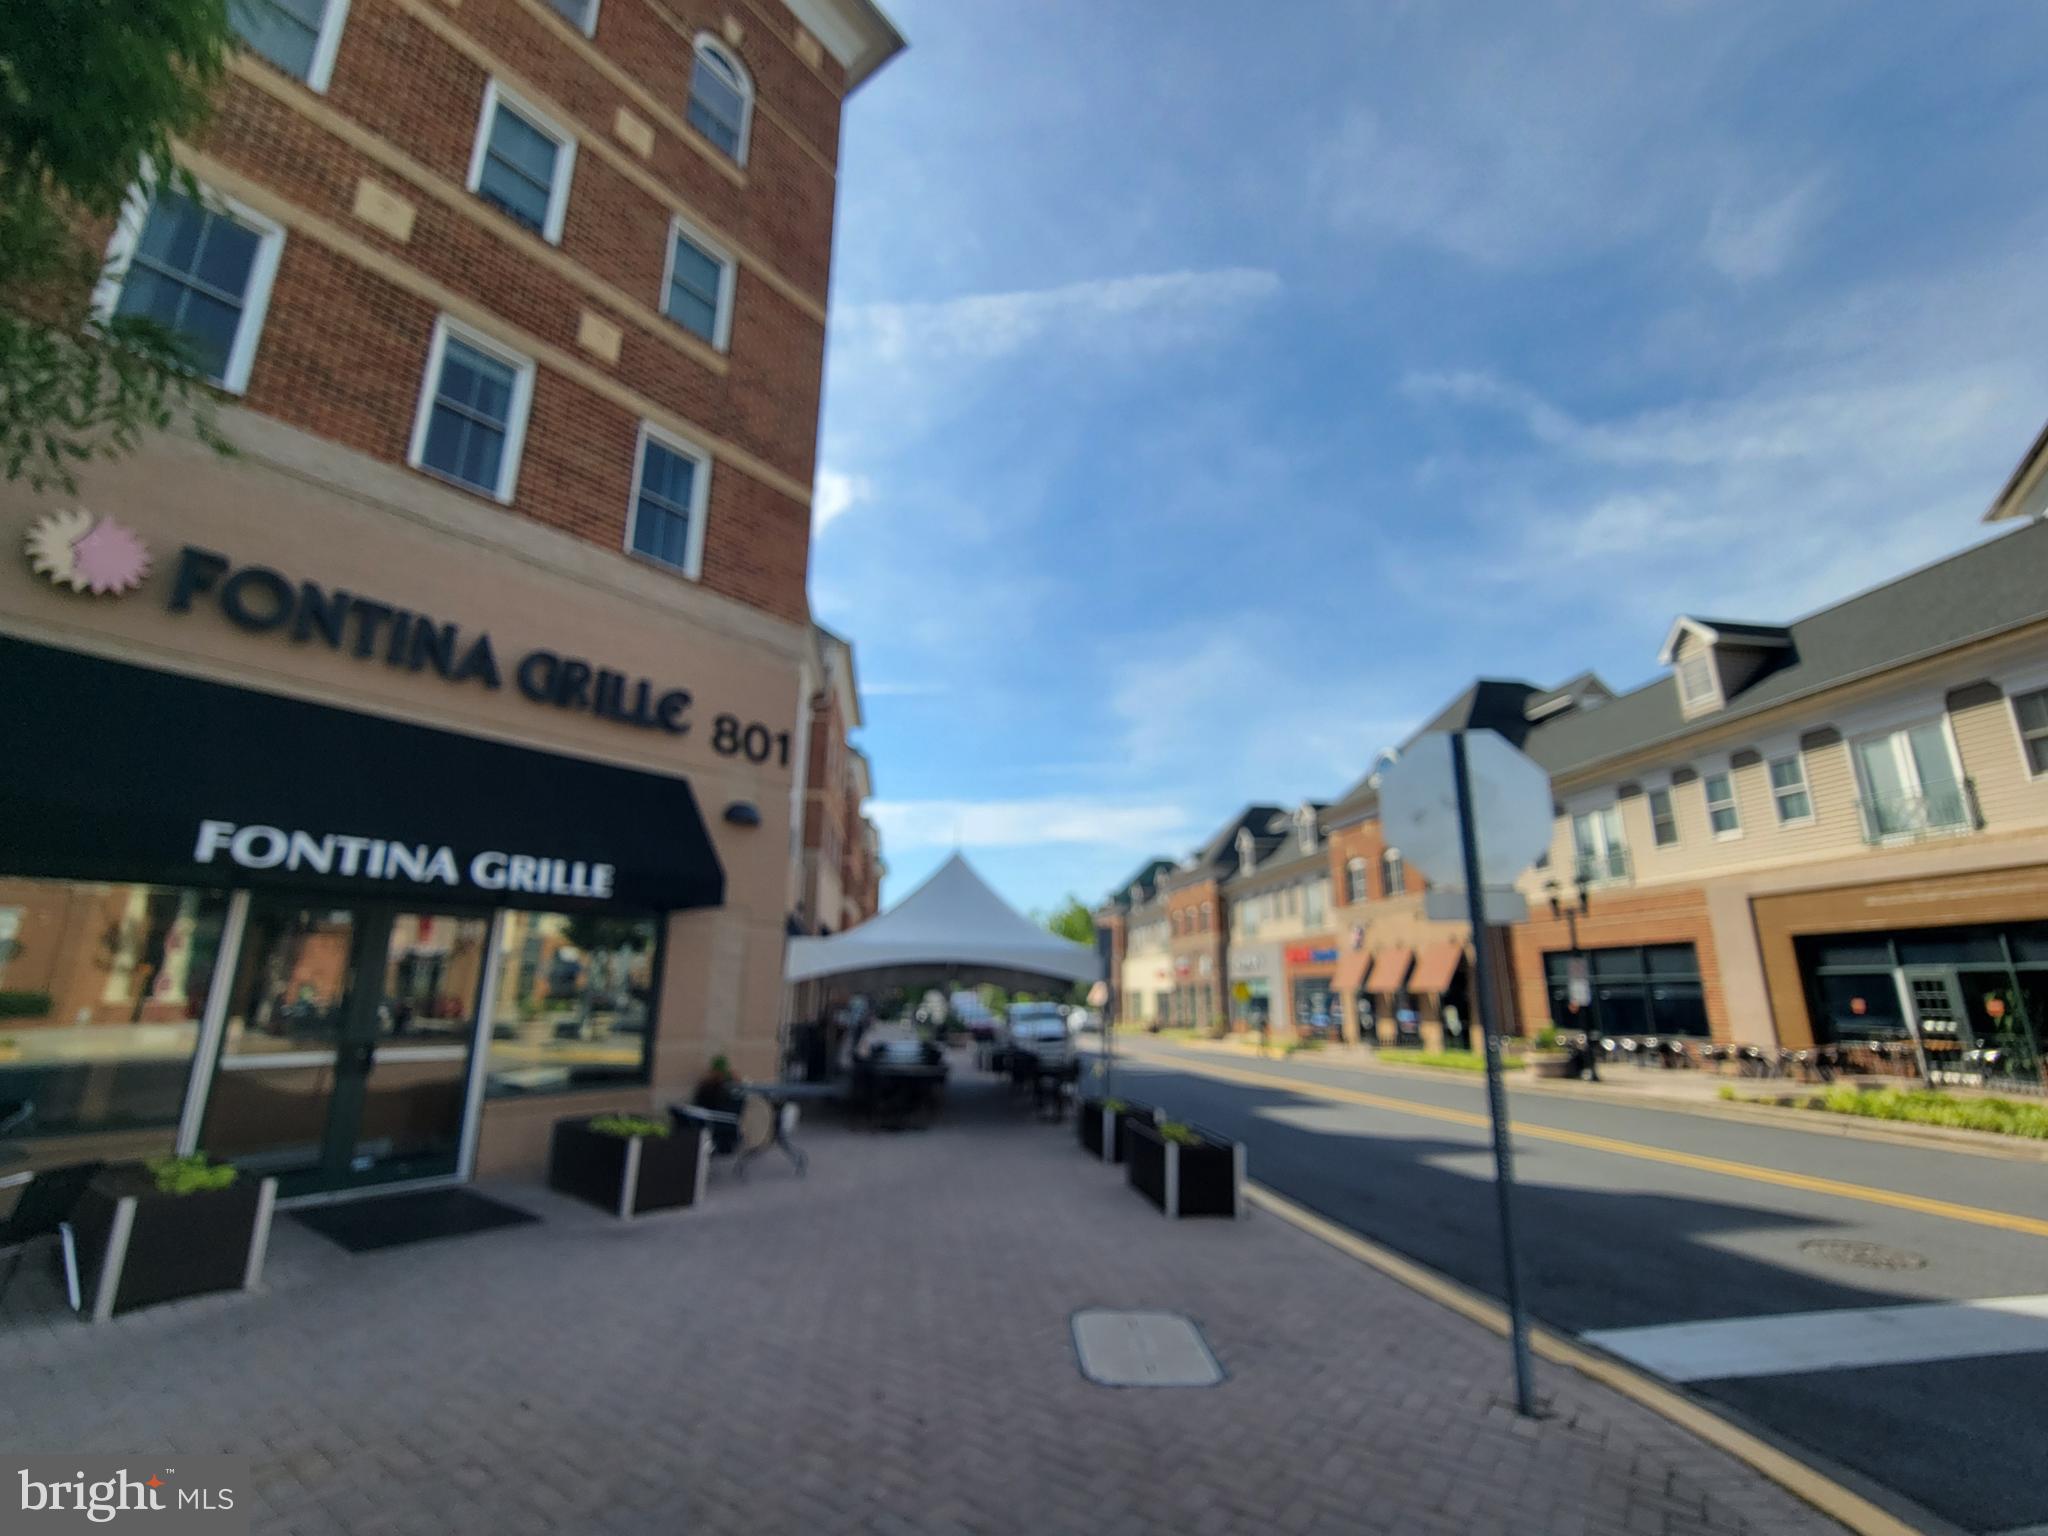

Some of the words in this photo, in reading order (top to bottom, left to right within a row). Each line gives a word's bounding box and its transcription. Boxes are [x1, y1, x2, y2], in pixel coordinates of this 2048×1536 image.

[168, 545, 500, 689] FONTINA
[517, 649, 692, 734] GRILLE
[712, 714, 790, 766] 801
[194, 820, 459, 886] FONTINA
[471, 851, 615, 898] GRILLE
